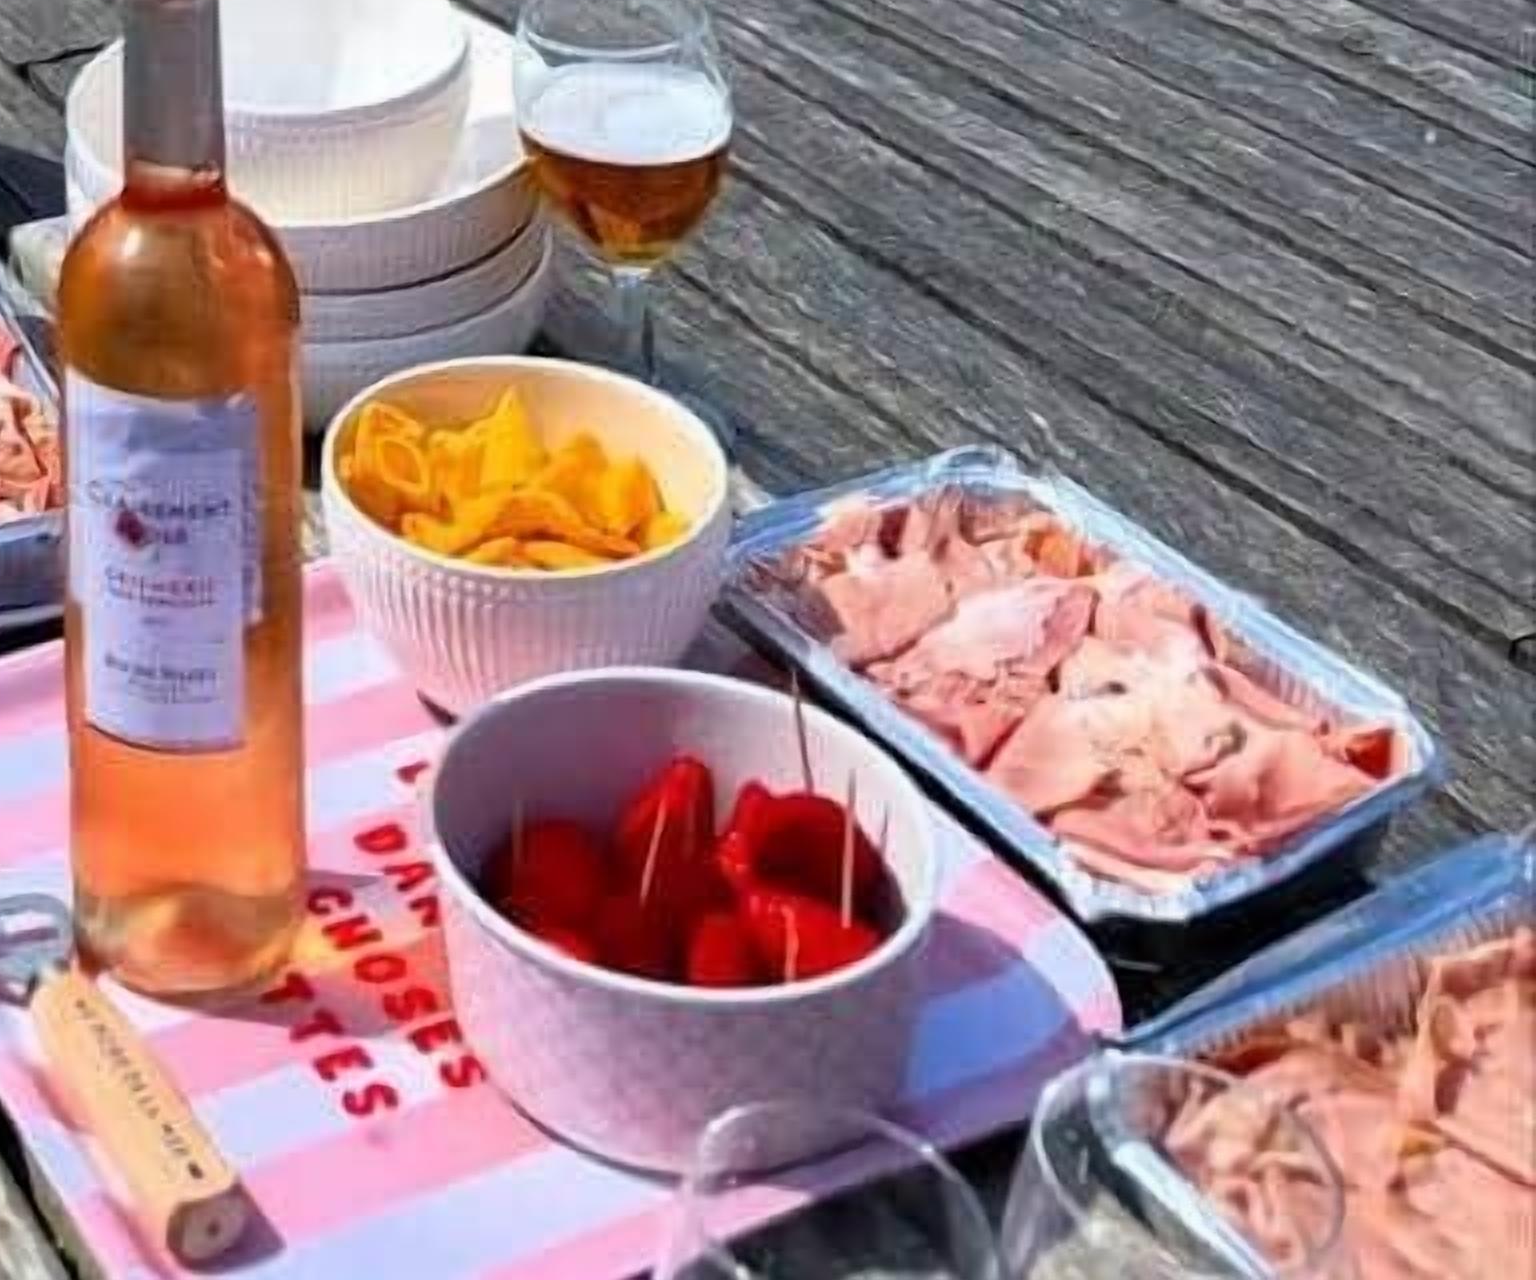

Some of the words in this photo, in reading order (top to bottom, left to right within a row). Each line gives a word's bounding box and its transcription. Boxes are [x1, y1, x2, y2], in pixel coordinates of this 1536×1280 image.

[352, 822, 441, 929] DAN
[260, 970, 400, 1117] TTES
[306, 886, 487, 1089] CHOSES
